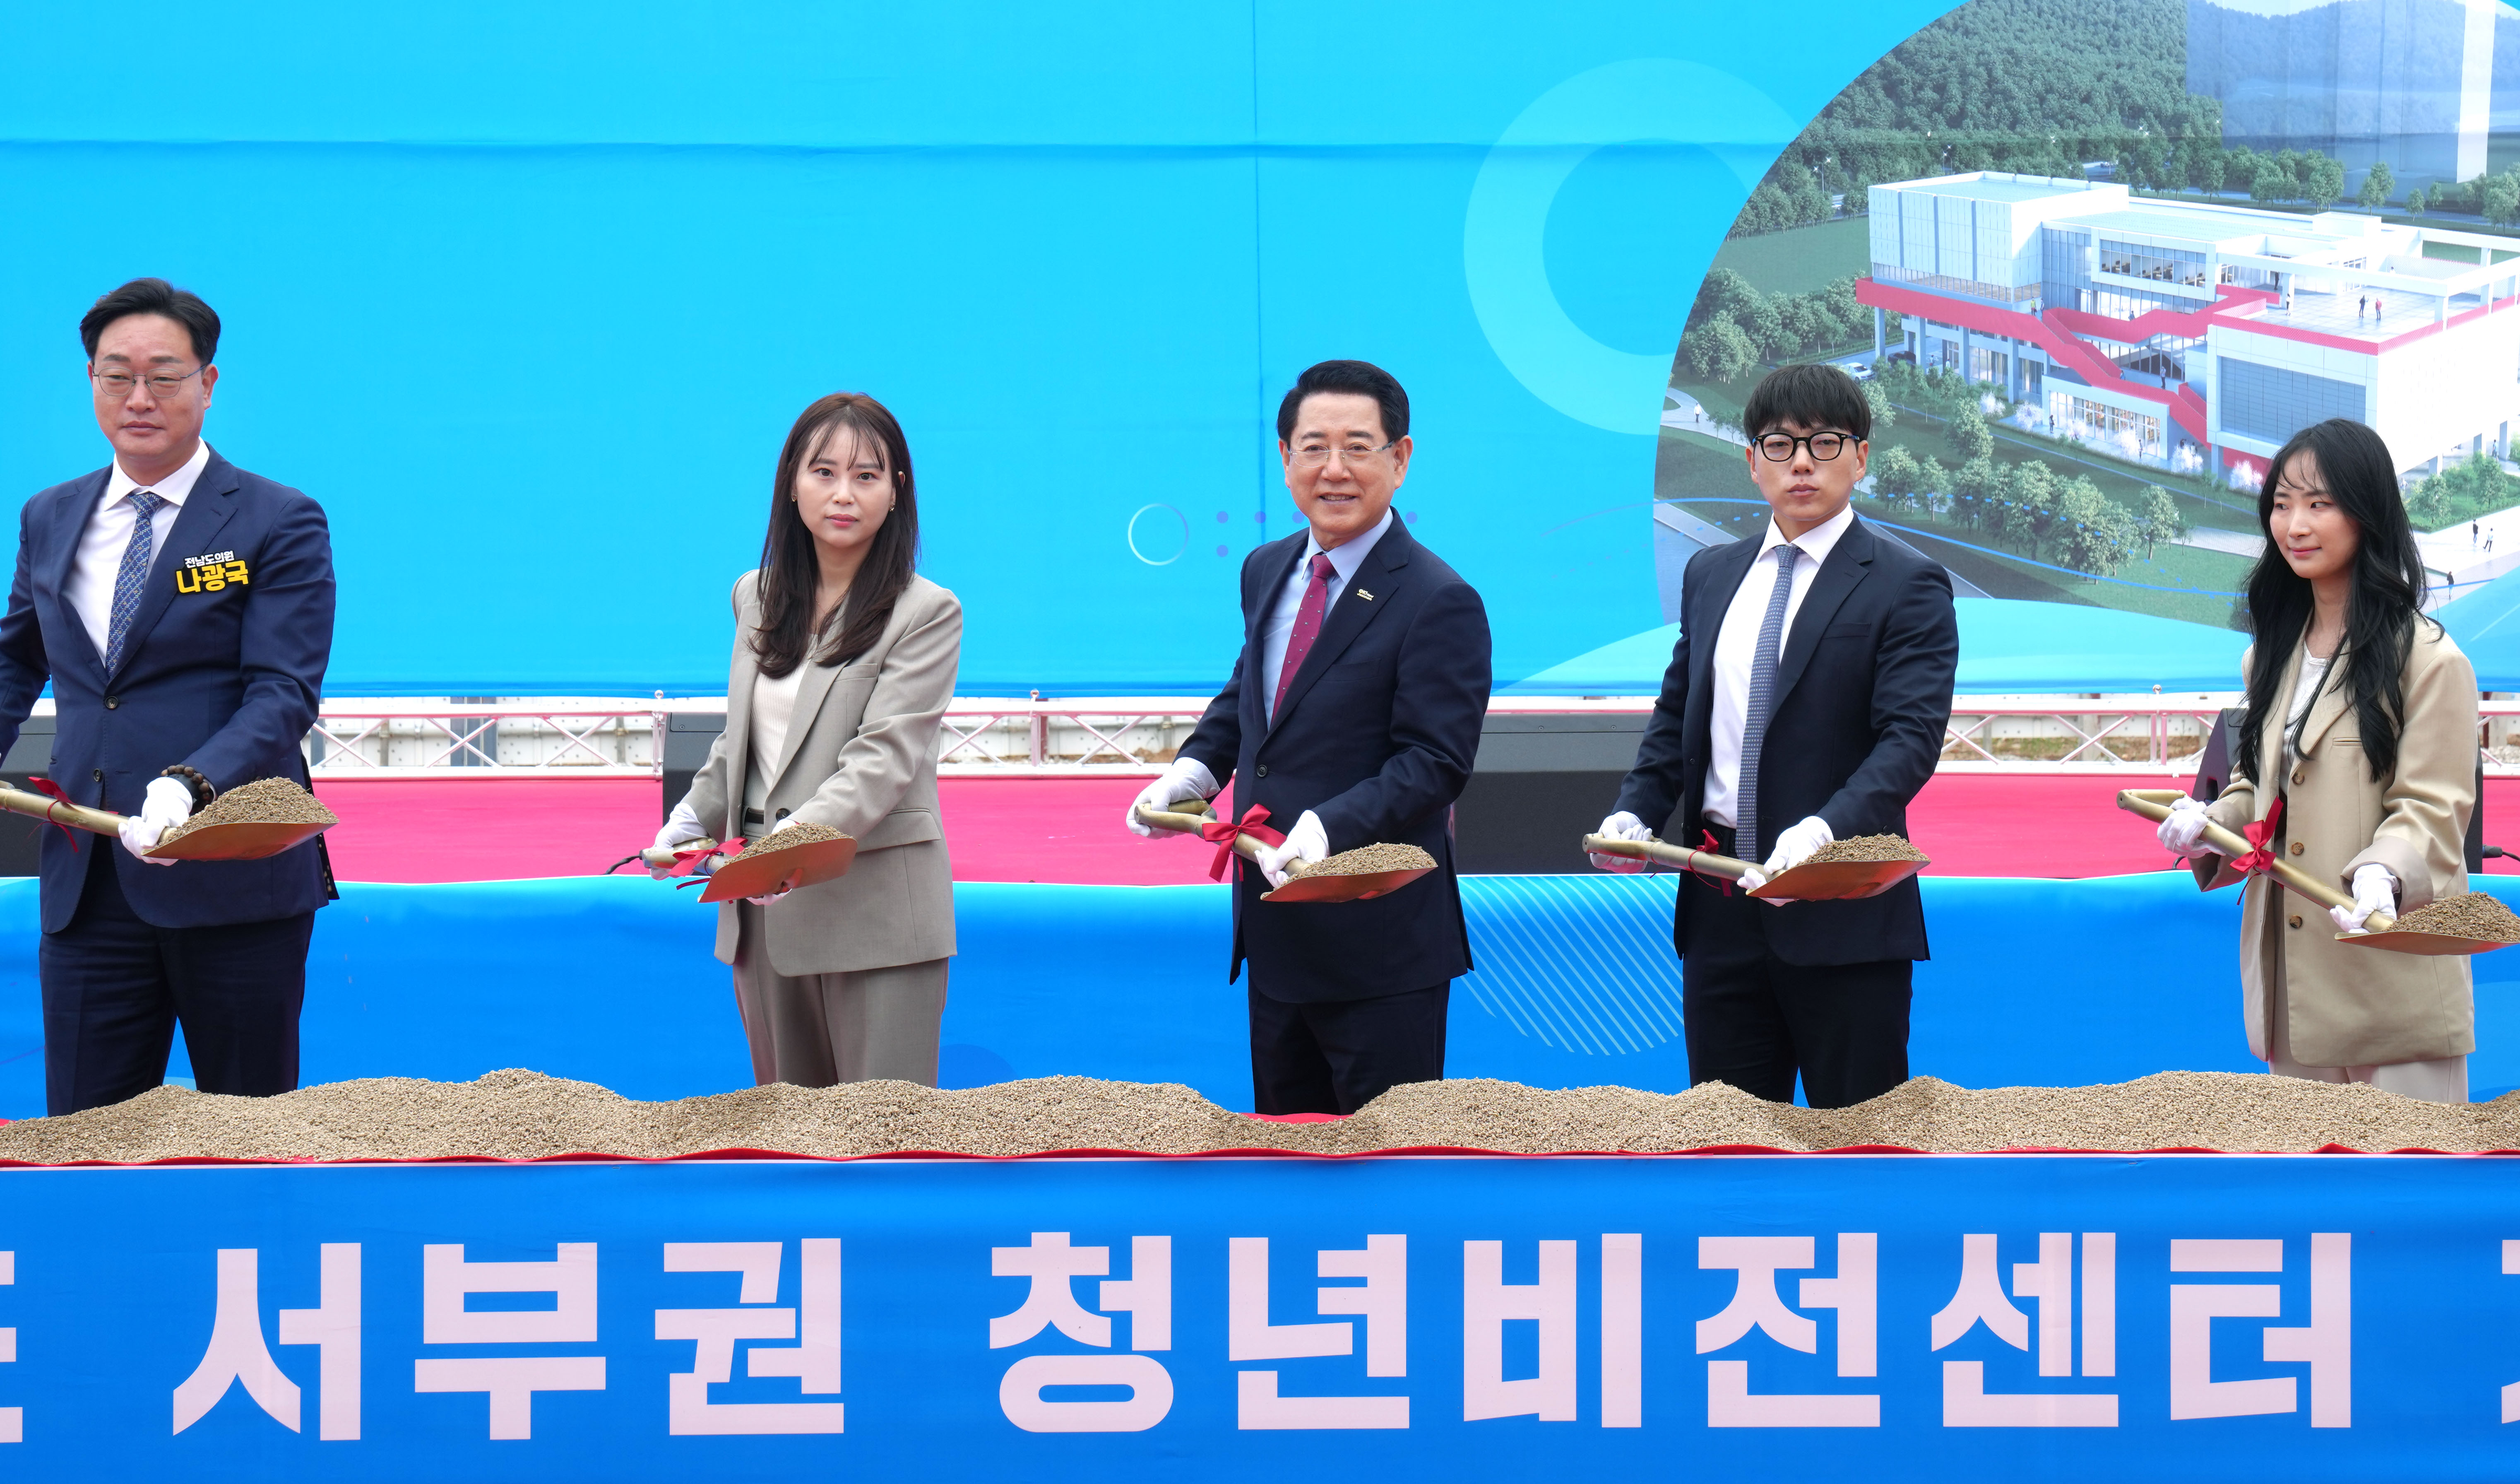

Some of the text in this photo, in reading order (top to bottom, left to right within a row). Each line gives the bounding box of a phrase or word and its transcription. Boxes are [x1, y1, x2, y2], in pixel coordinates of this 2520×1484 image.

[176, 560, 248, 593] 나광국
[185, 551, 234, 569] 전남도의원
[173, 1238, 844, 1441] 서부권
[990, 1232, 2351, 1432] 청년비전센터
